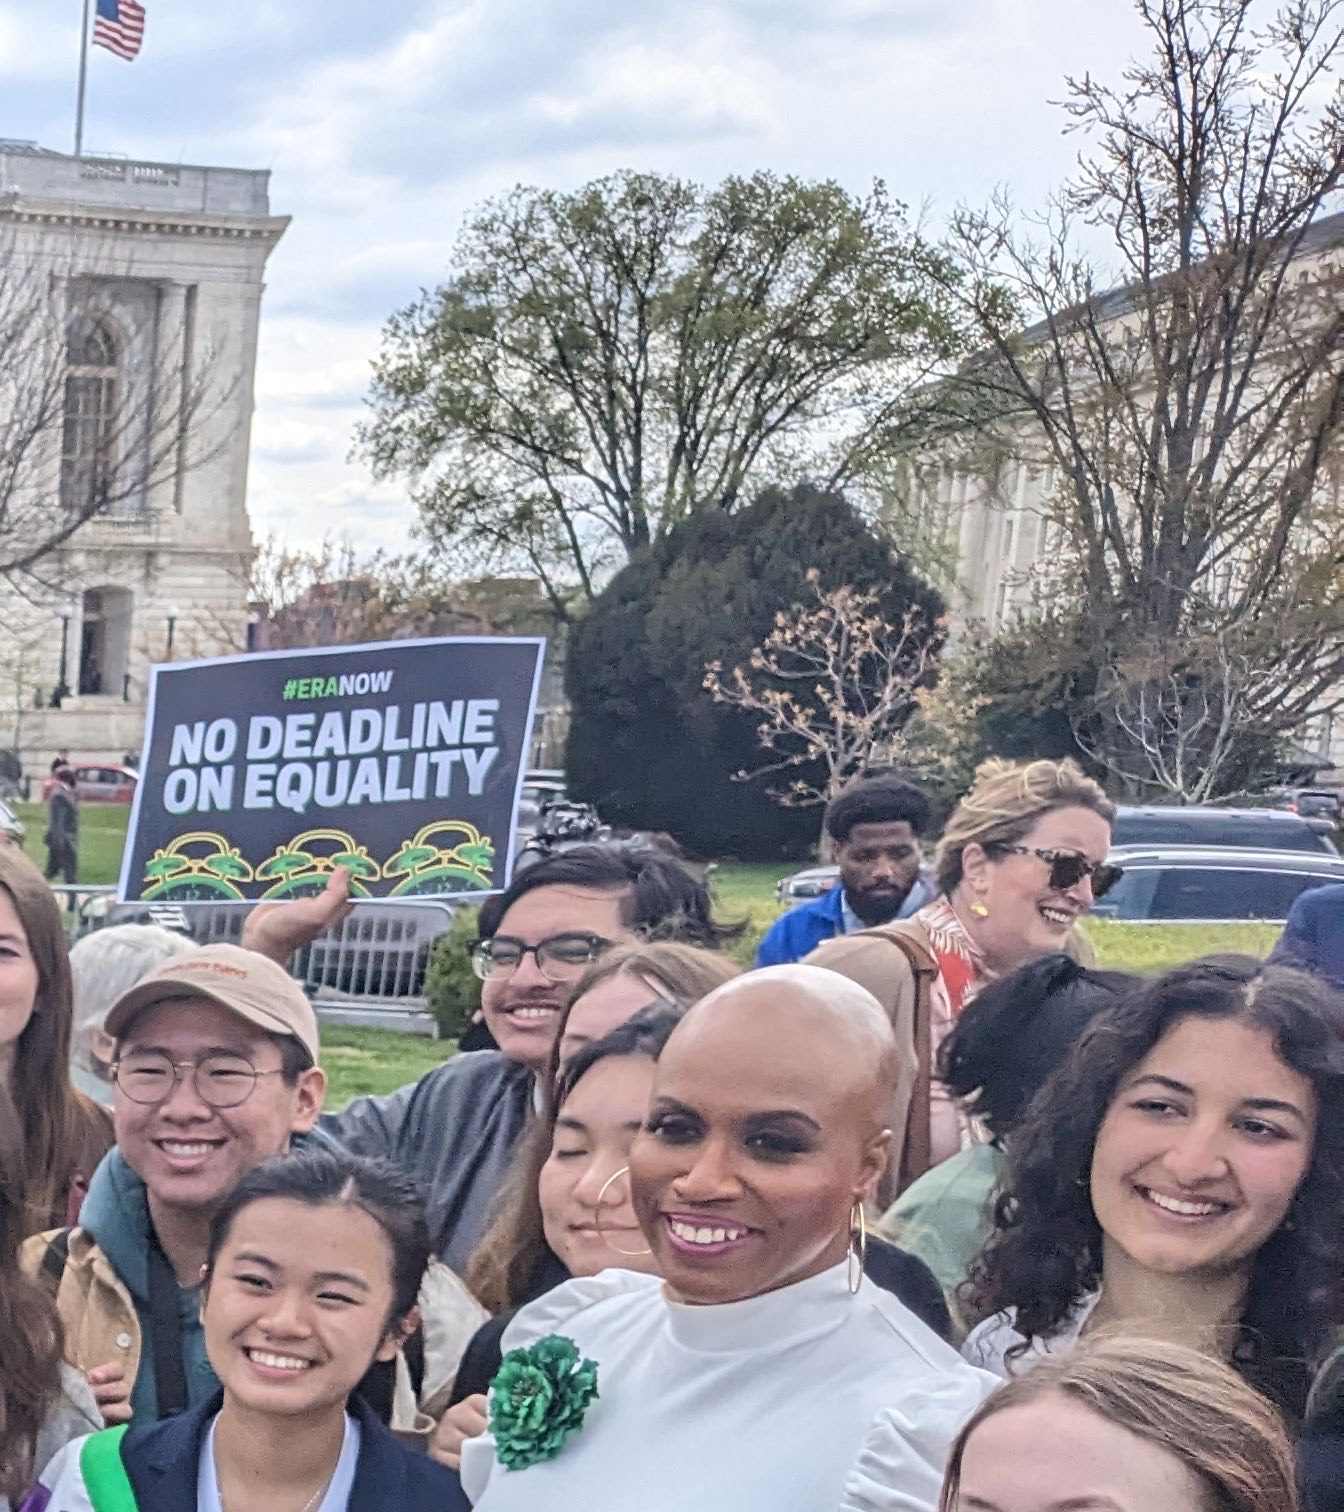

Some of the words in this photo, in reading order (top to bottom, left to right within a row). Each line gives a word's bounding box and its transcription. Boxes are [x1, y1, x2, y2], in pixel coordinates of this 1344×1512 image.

[282, 670, 393, 701] #ERANOW
[169, 718, 238, 767] NO
[246, 699, 499, 760] DEADLINE
[164, 766, 234, 814] ON
[243, 747, 499, 814] EQUALITY
